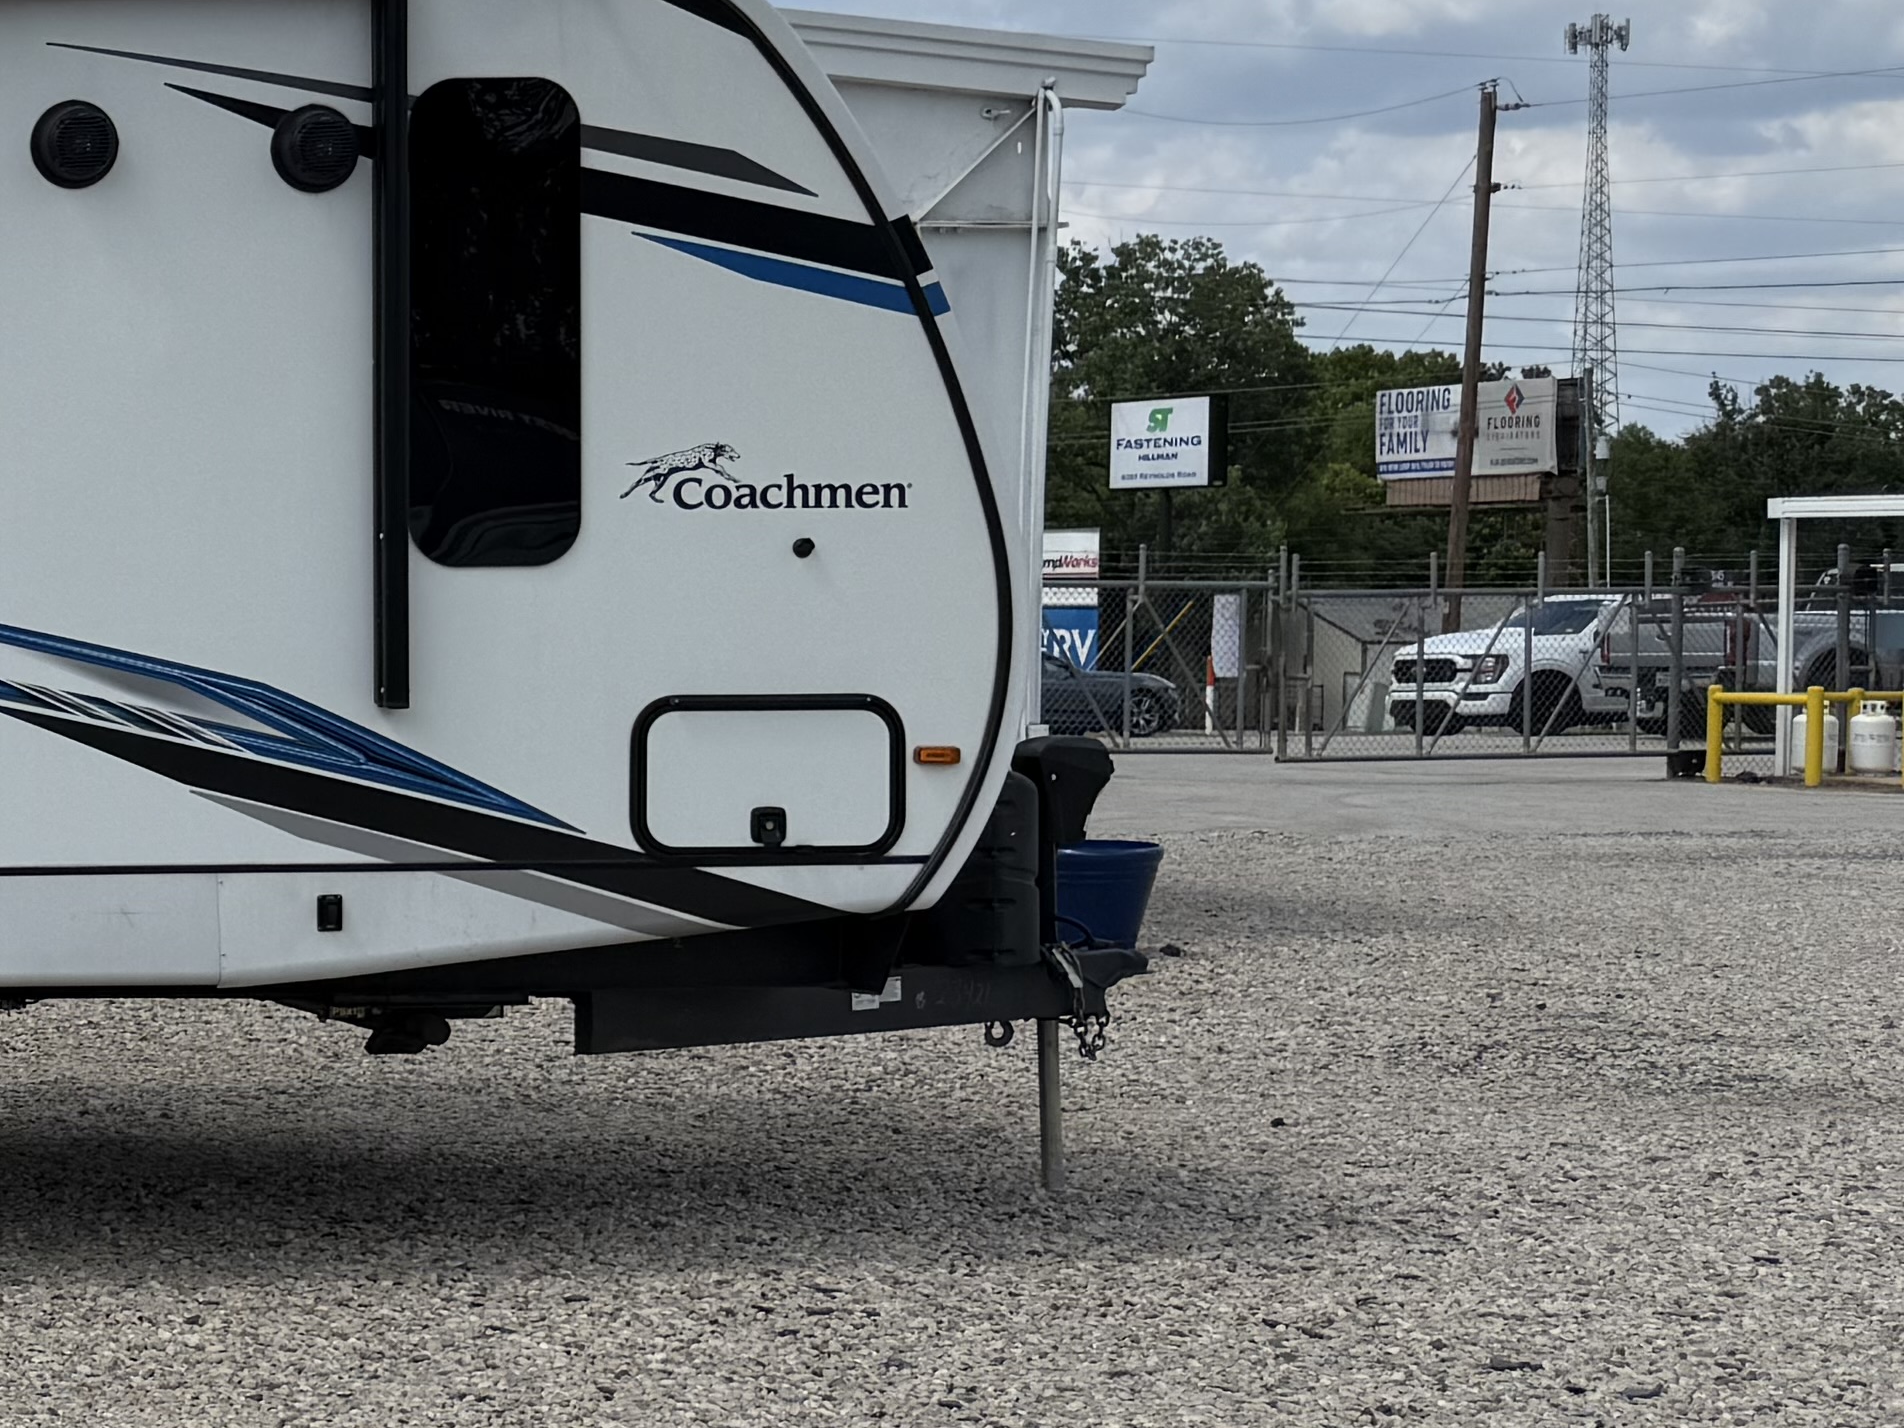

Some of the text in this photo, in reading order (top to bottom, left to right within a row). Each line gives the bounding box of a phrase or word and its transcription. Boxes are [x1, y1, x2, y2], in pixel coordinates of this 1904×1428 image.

[1379, 387, 1451, 415] FLOORING
[1379, 414, 1419, 431] FOR YOUR
[1487, 415, 1541, 430] FLOORING
[1116, 435, 1202, 451] FASTENING
[1379, 429, 1430, 456] FAMILY
[1138, 452, 1179, 462] HILLMAN
[672, 473, 909, 510] Coachmen
[1052, 628, 1097, 667] RV
